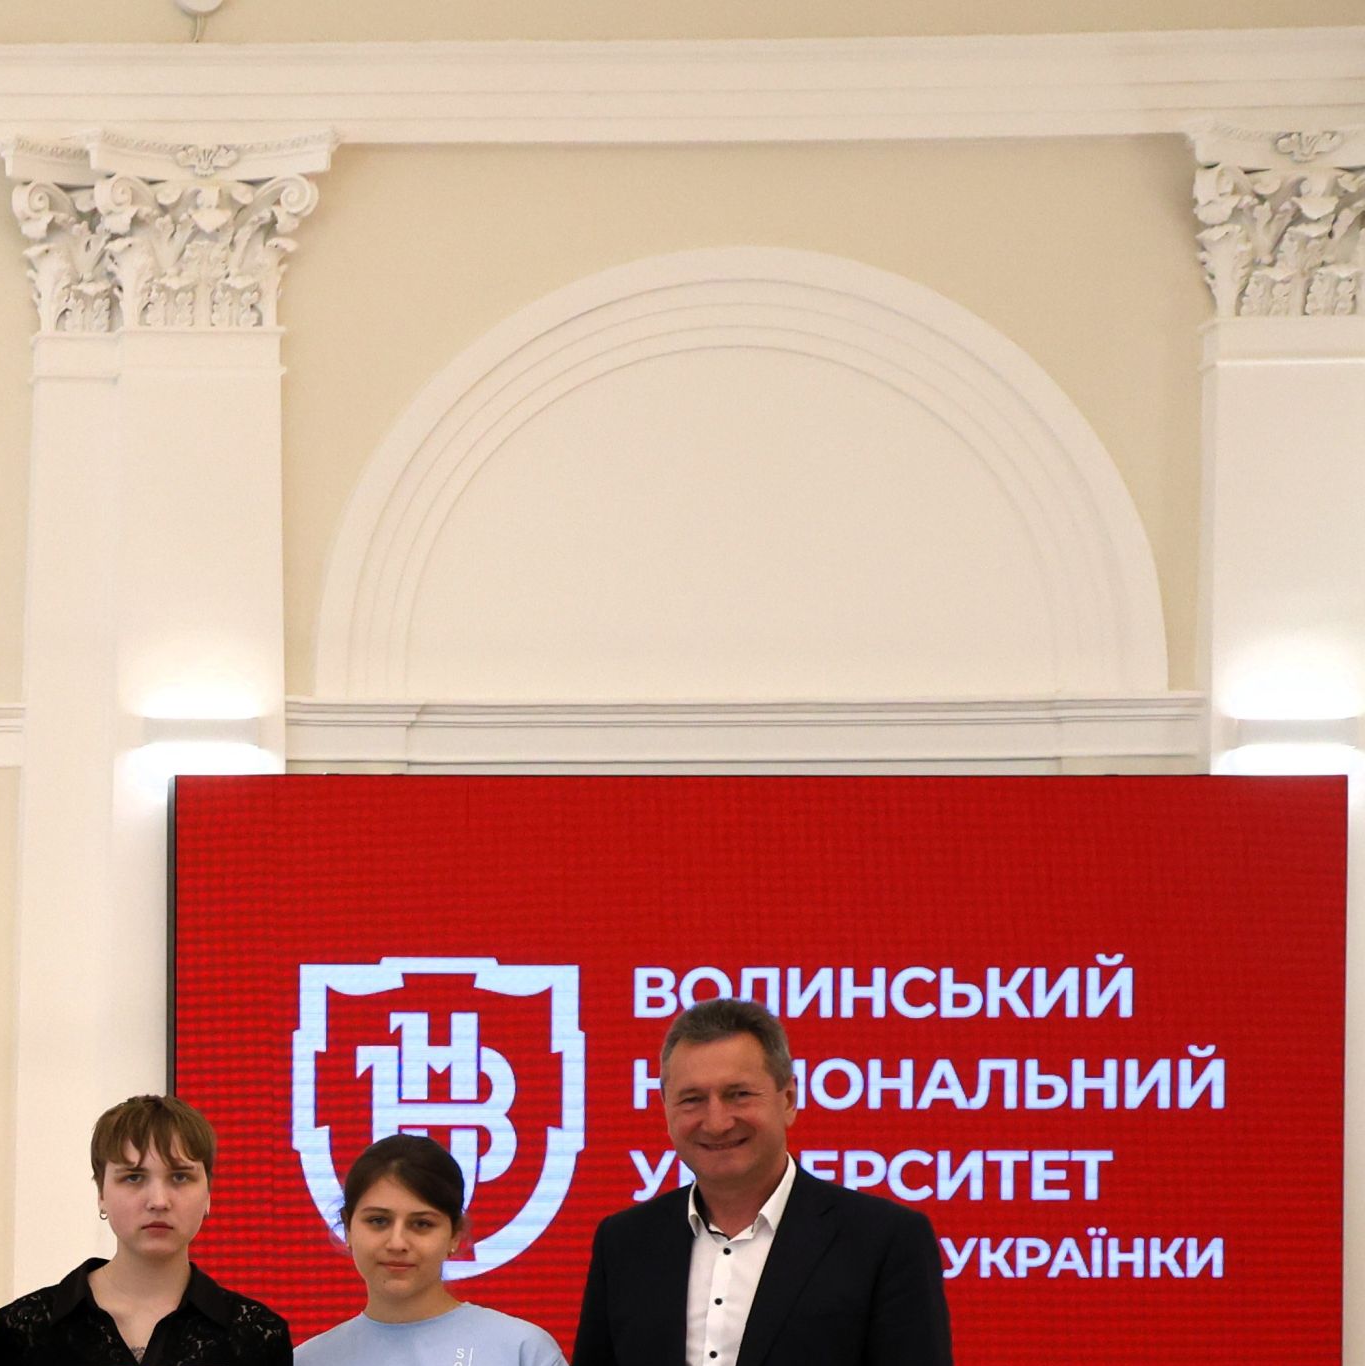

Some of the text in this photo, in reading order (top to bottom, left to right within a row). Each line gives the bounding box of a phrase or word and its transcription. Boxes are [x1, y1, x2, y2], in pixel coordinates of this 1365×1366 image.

[633, 953, 1134, 1019] ВОЛИНСЬКИЙ
[633, 1044, 1226, 1110] НІОНАЛЬНИЙ
[940, 1227, 1225, 1279] УКРАЇНКИ
